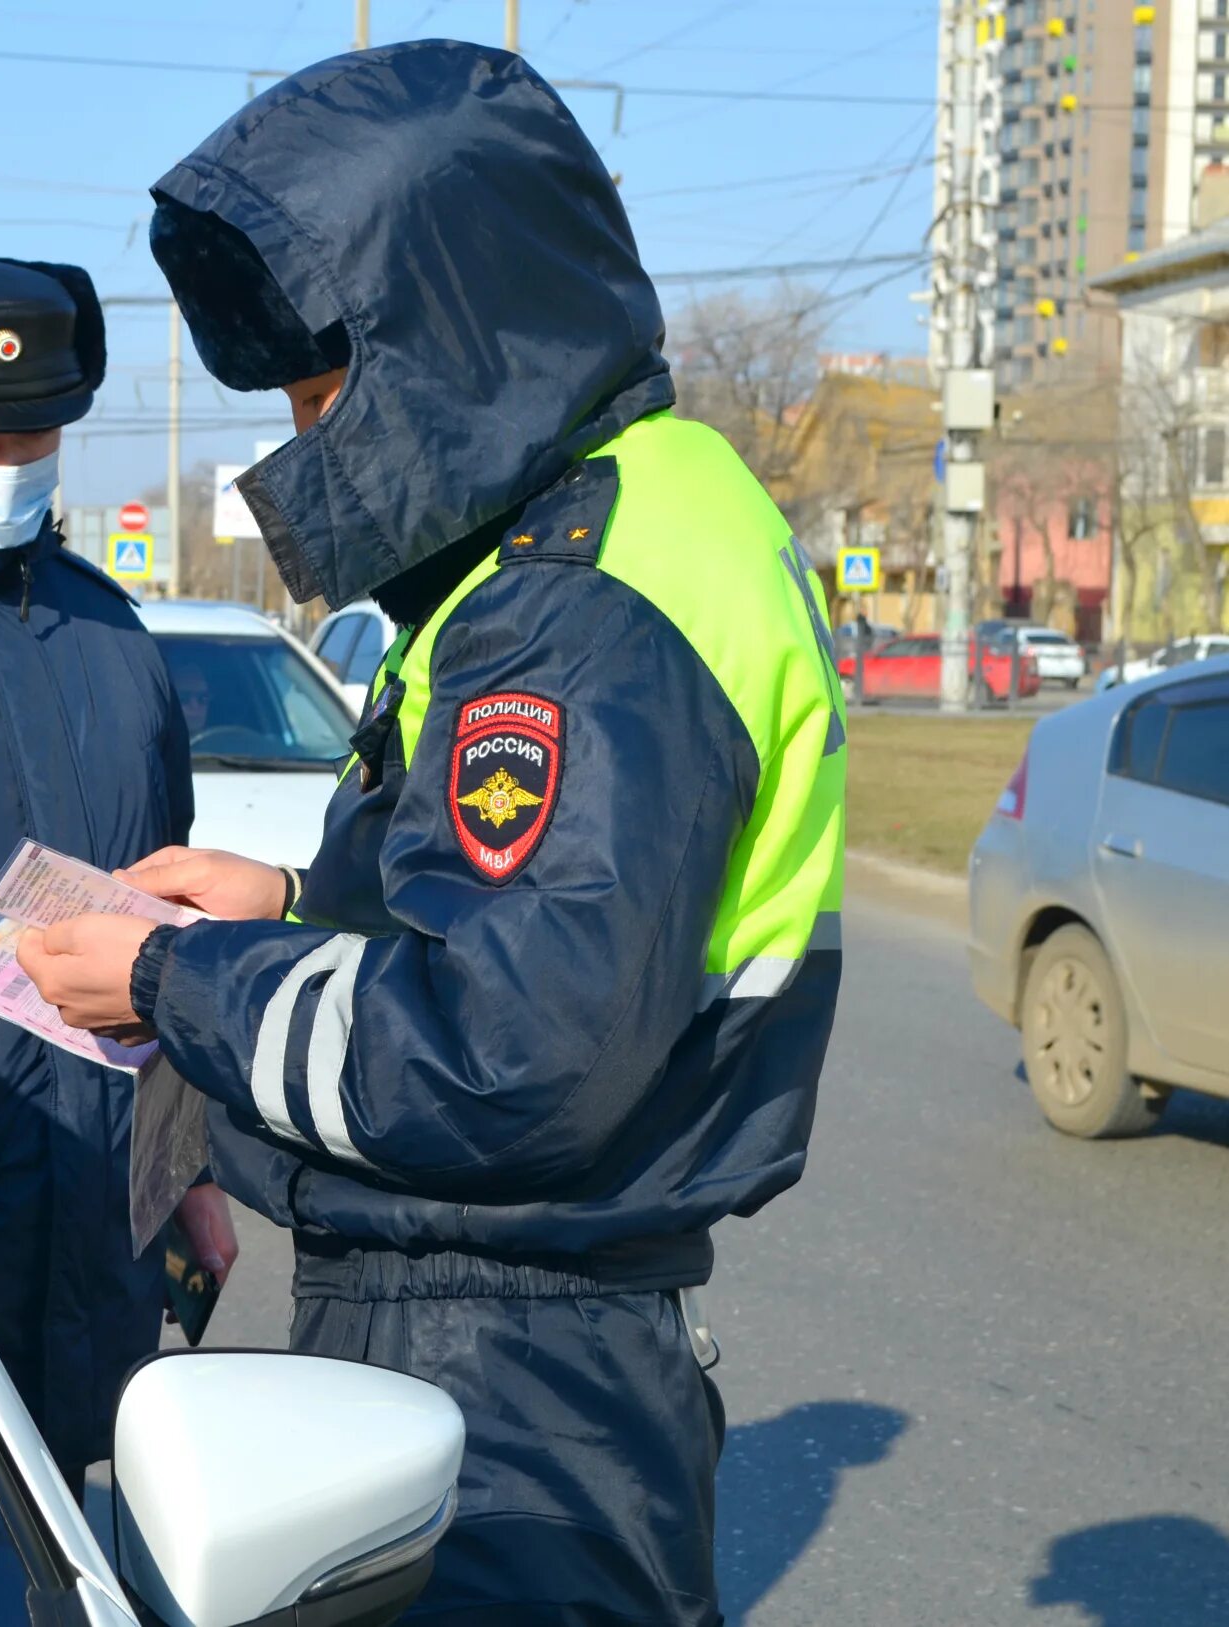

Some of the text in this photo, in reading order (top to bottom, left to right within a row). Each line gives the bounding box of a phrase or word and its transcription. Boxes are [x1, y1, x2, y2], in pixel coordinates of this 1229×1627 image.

[467, 700, 552, 726] ПОЛИЦИЯ
[466, 737, 543, 767] РОССИЯ
[479, 847, 514, 869] МВД
